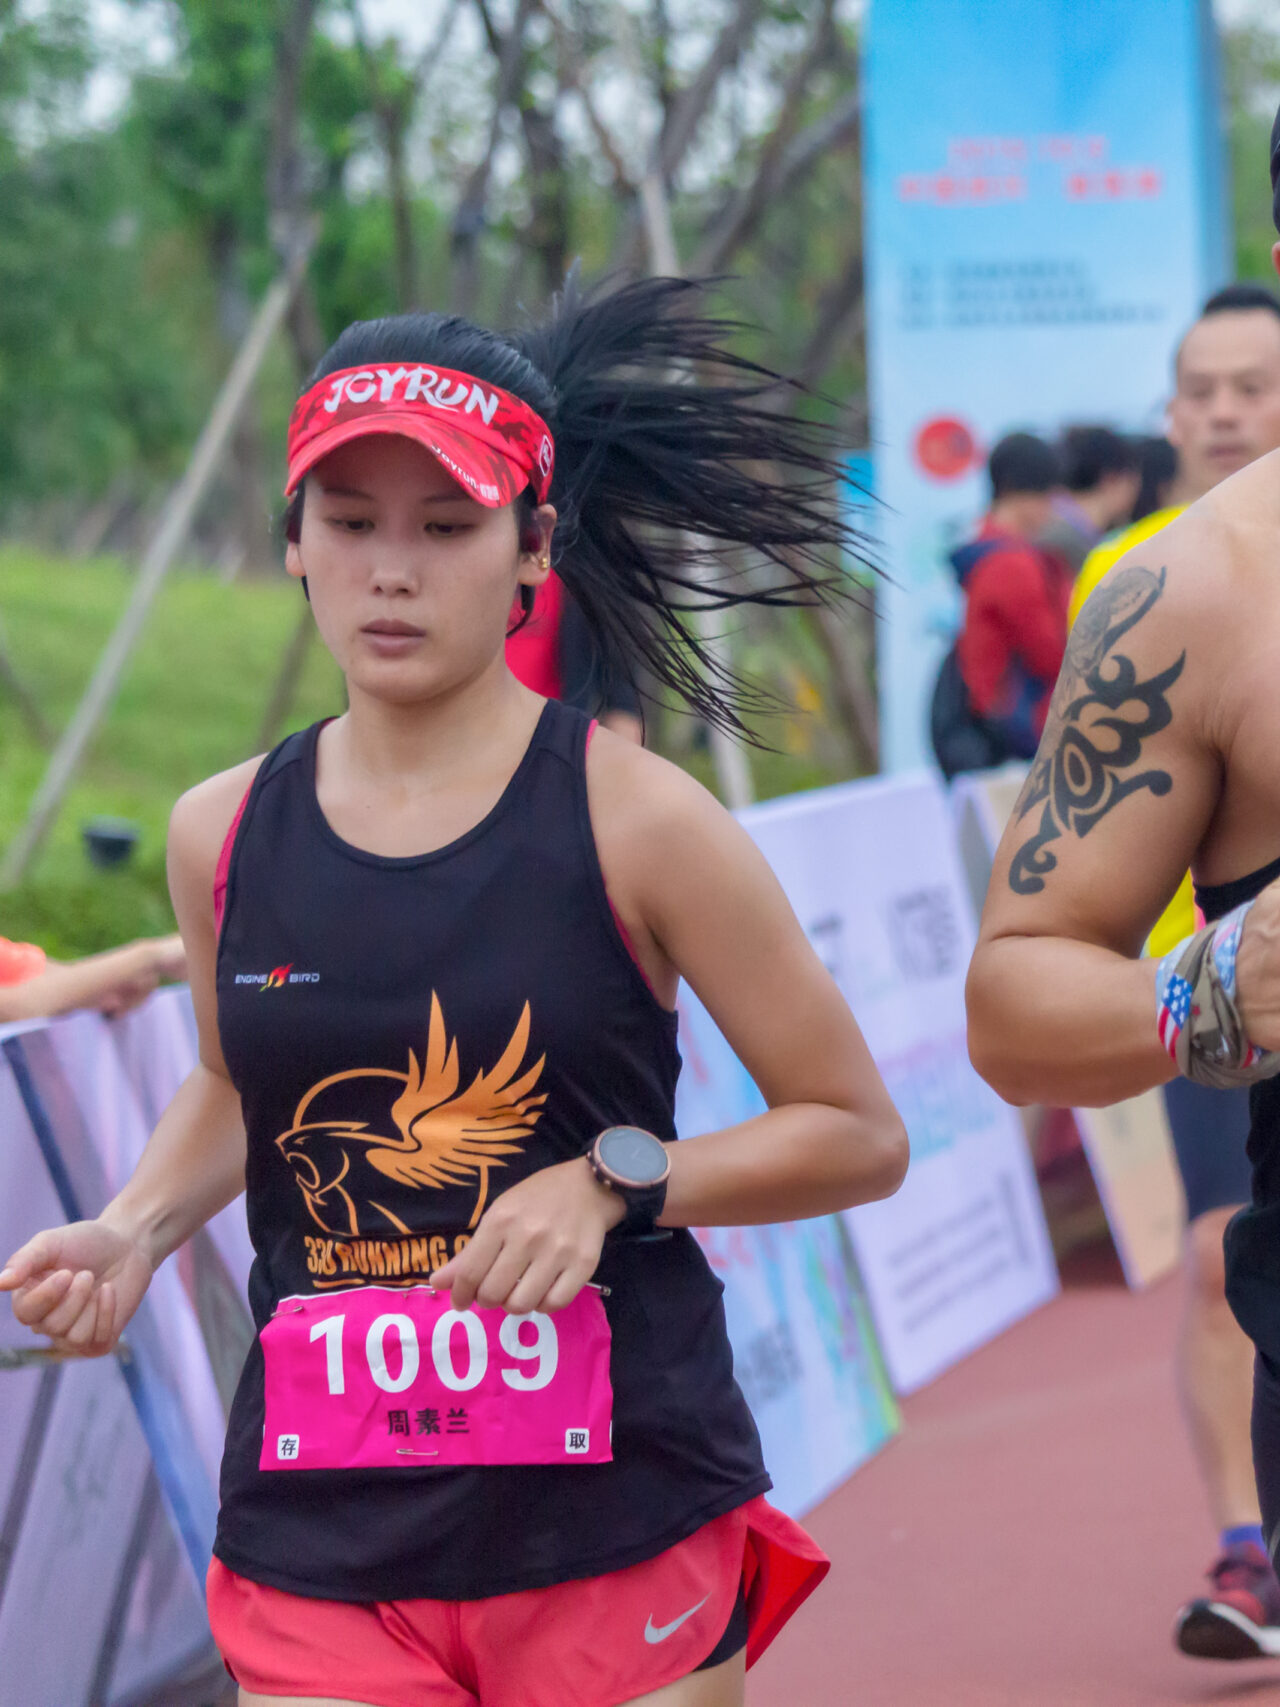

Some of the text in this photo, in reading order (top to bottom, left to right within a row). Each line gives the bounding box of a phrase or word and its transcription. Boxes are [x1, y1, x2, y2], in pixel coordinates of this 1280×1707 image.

[323, 366, 499, 425] JOYRUN
[235, 973, 321, 984] ENGINE BIRD
[335, 1235, 448, 1276] RUNNING
[309, 1309, 559, 1395] 1009
[387, 1408, 470, 1437] 周素兰
[281, 1438, 297, 1456] 存
[569, 1432, 586, 1450] 取
